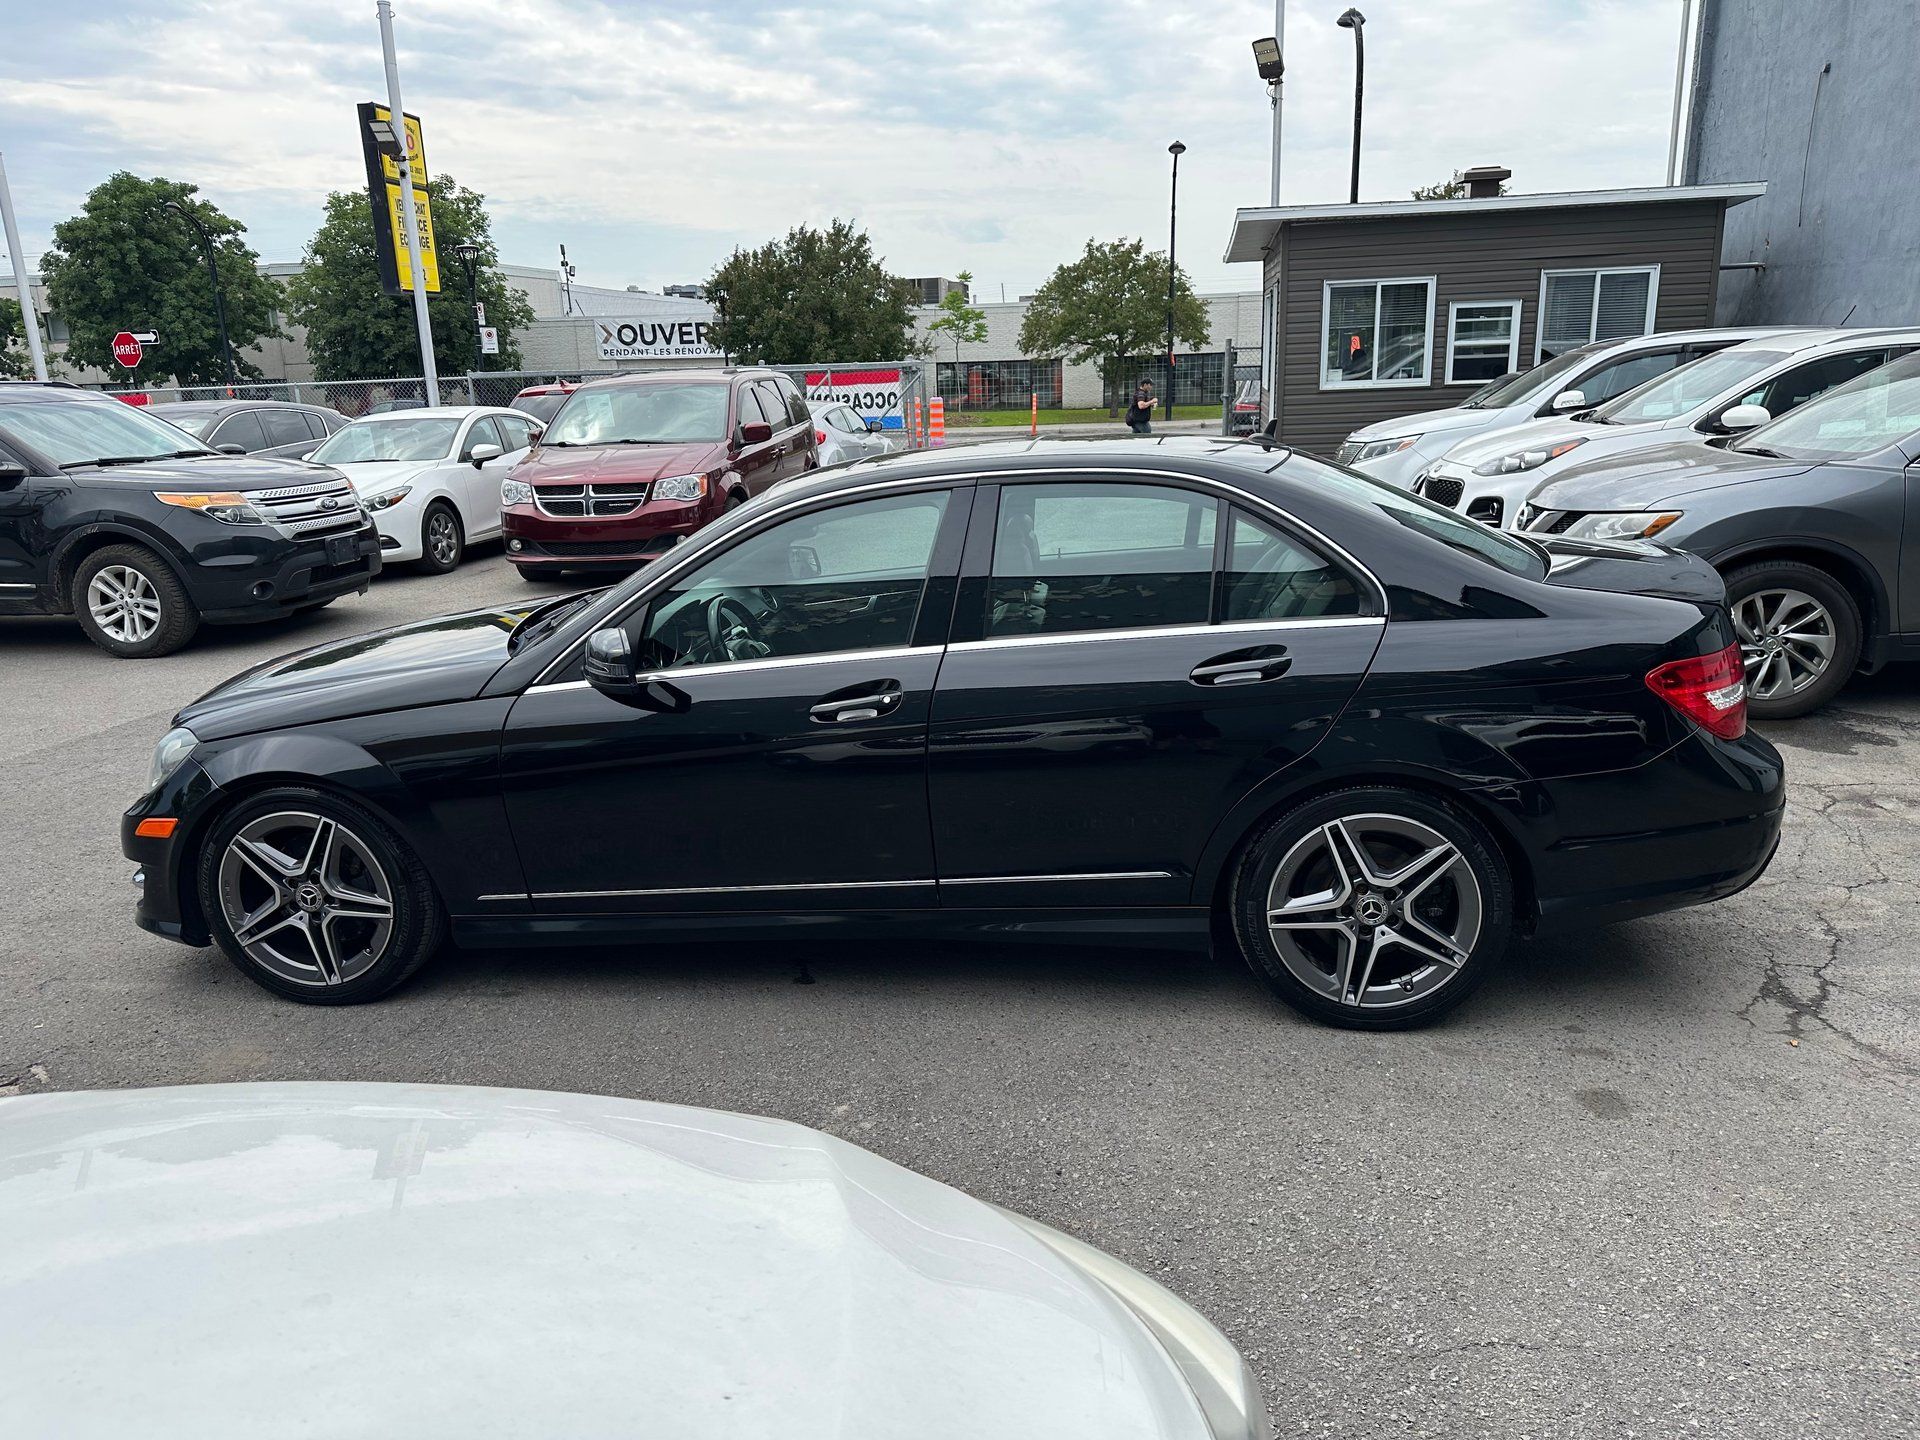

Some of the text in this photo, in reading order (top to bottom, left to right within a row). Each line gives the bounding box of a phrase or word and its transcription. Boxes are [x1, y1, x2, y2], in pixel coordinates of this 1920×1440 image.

[397, 216, 428, 232] FICE
[617, 322, 711, 346] OUVER
[115, 343, 139, 355] ARRÊT
[604, 348, 649, 356] PENDANT
